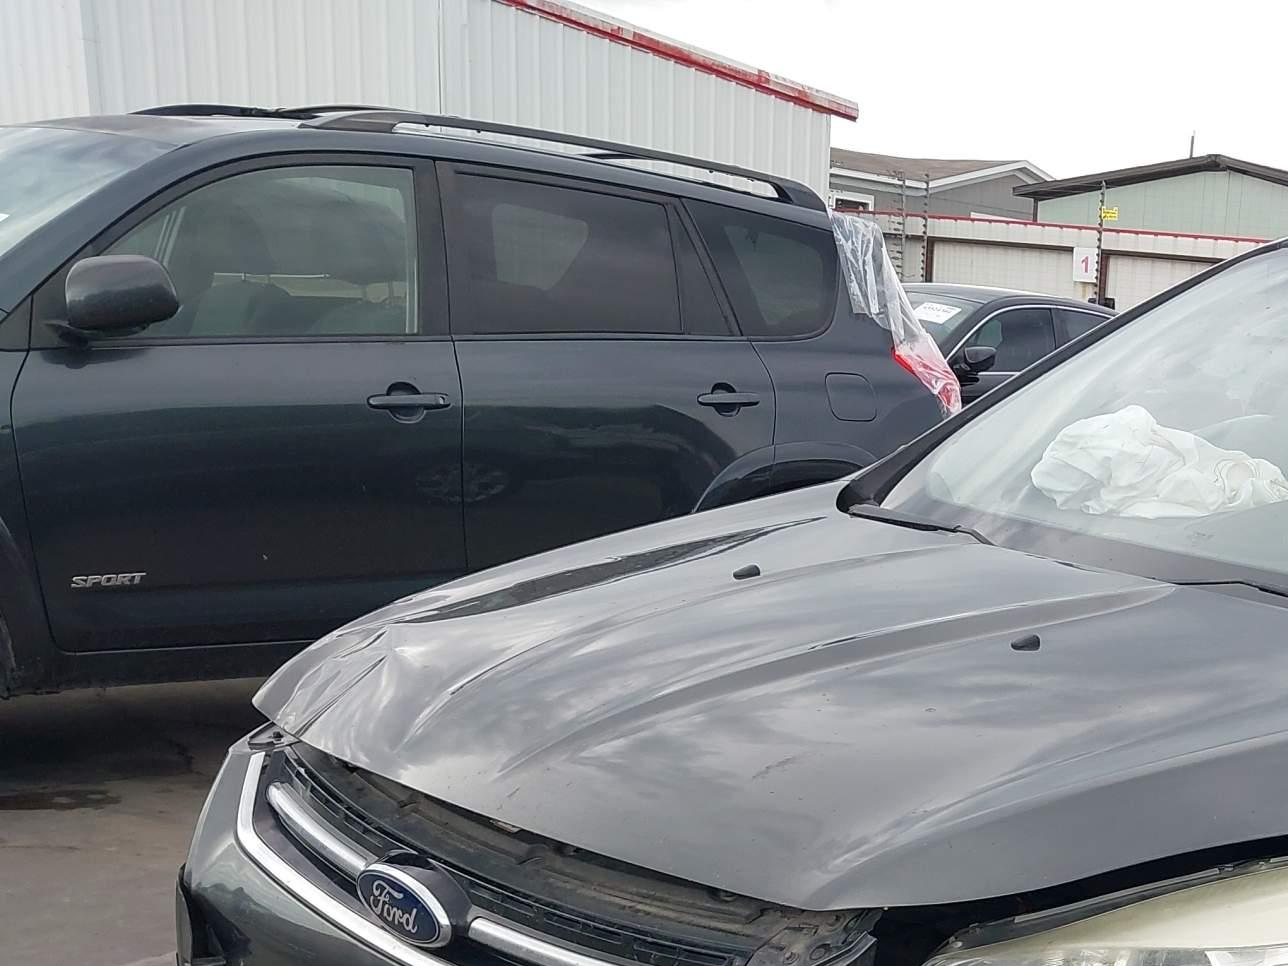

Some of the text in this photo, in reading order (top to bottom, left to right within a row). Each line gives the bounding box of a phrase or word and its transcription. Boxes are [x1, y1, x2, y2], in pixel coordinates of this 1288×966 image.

[1081, 255, 1089, 274] 1
[71, 572, 147, 587] SPORT
[370, 880, 418, 934] Ford
